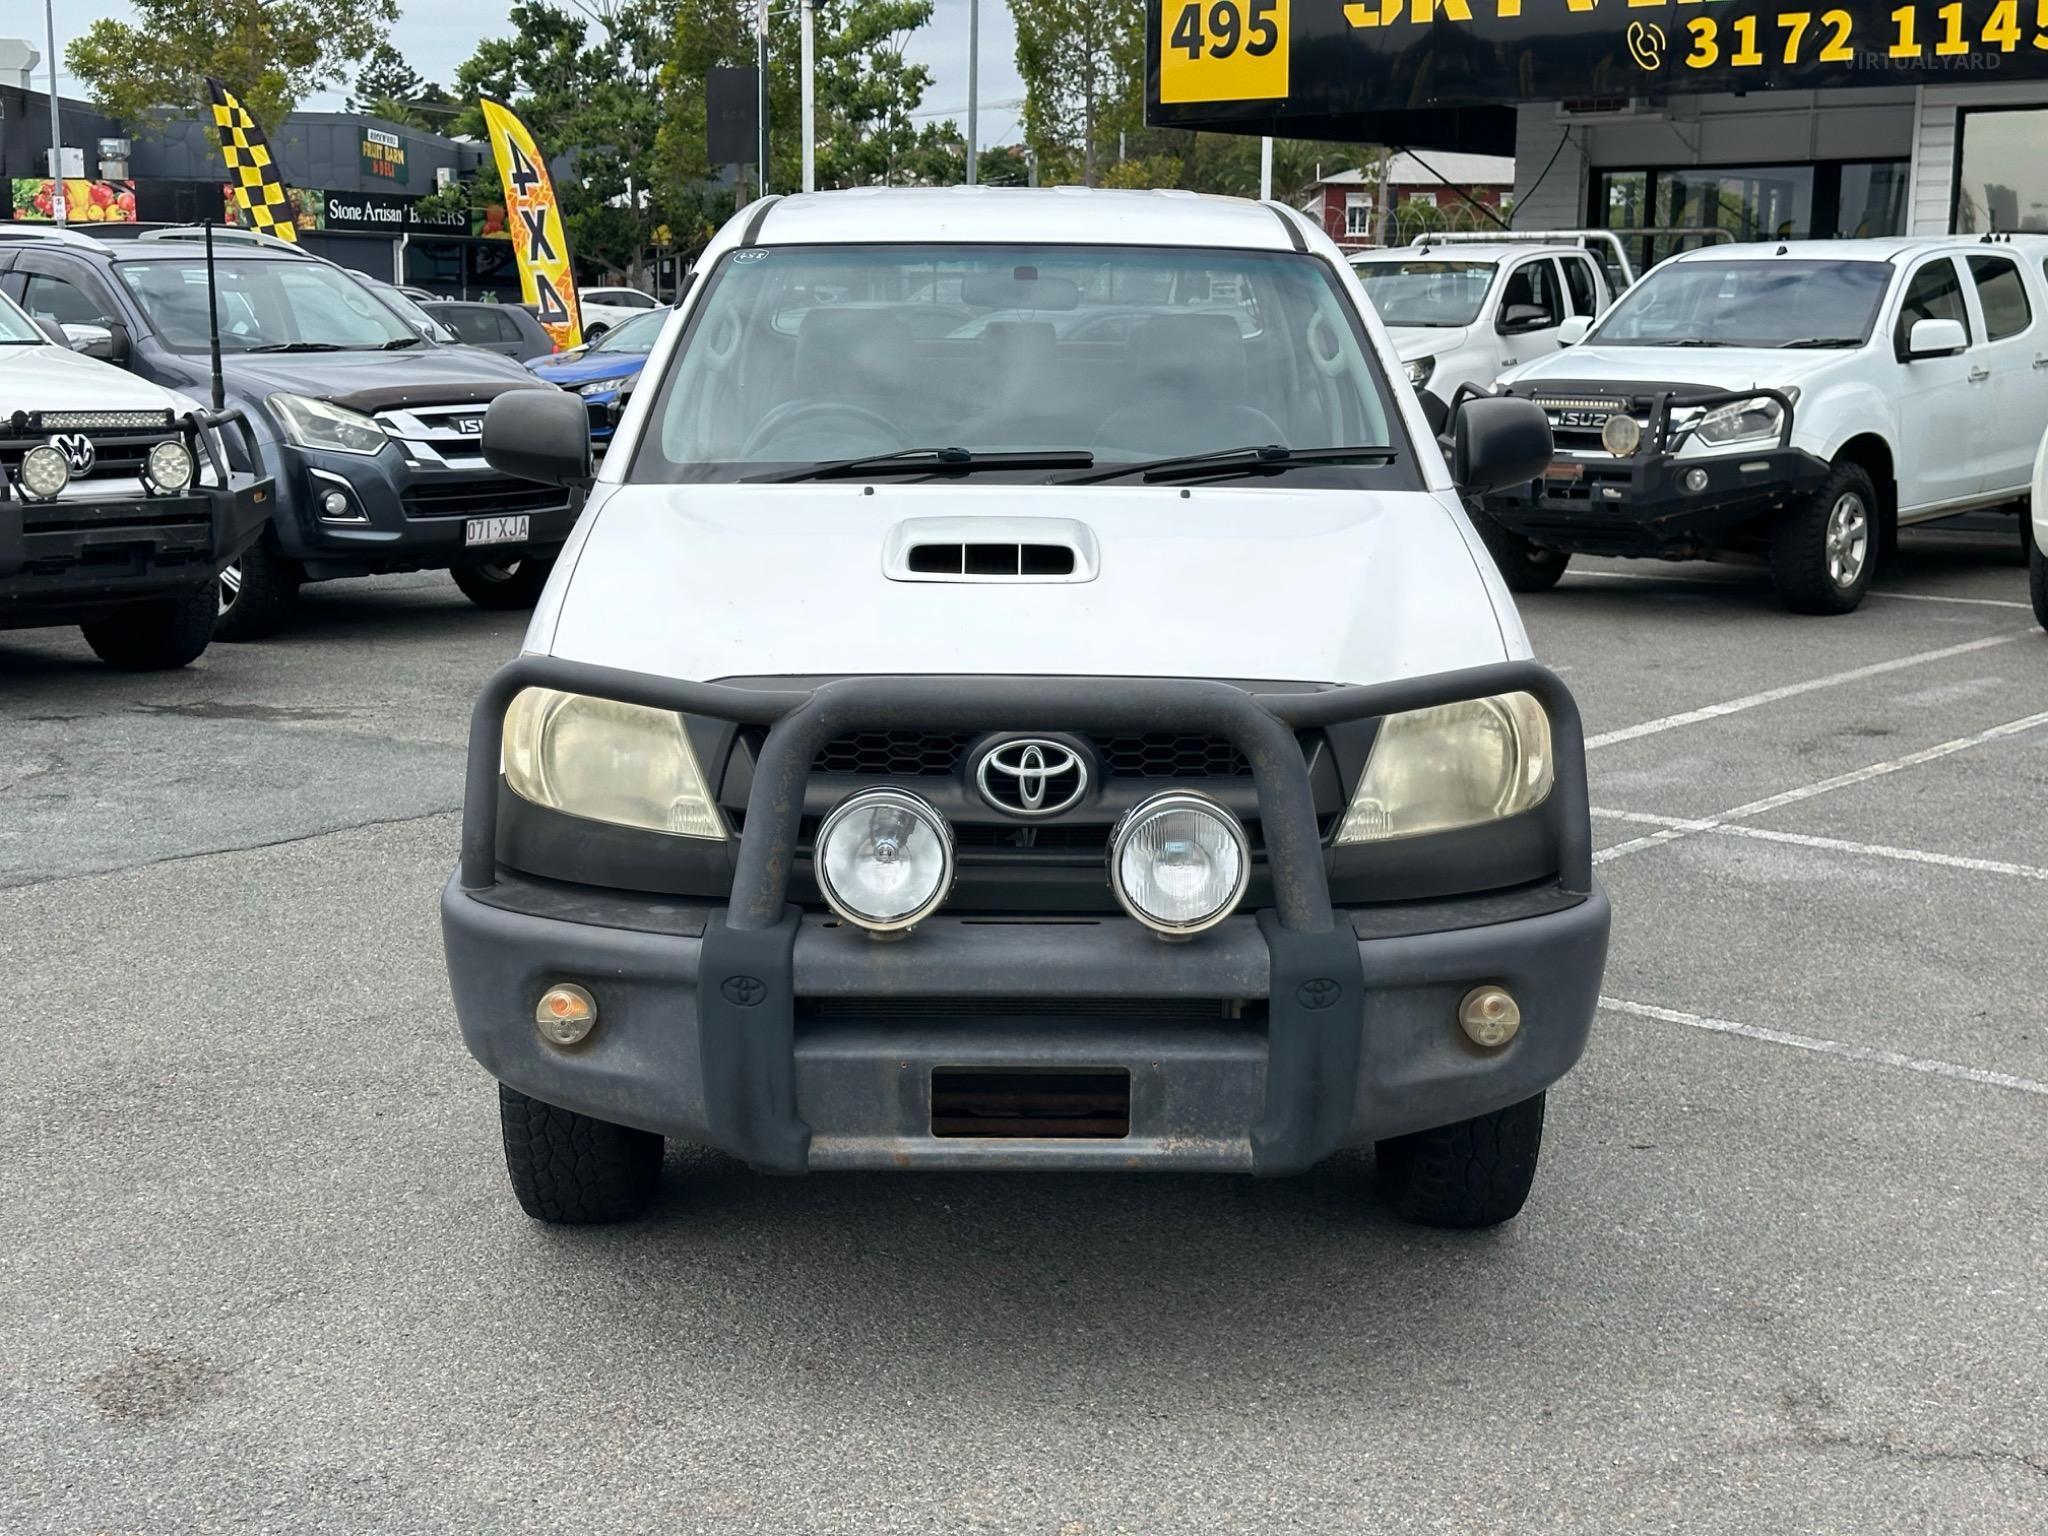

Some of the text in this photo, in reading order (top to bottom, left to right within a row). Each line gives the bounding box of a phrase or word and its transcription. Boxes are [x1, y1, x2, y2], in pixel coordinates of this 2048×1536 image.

[1170, 0, 1279, 59] 495
[1685, 9, 1854, 68] 3172
[329, 199, 362, 220] Stone
[1560, 412, 1613, 427] ISUZ
